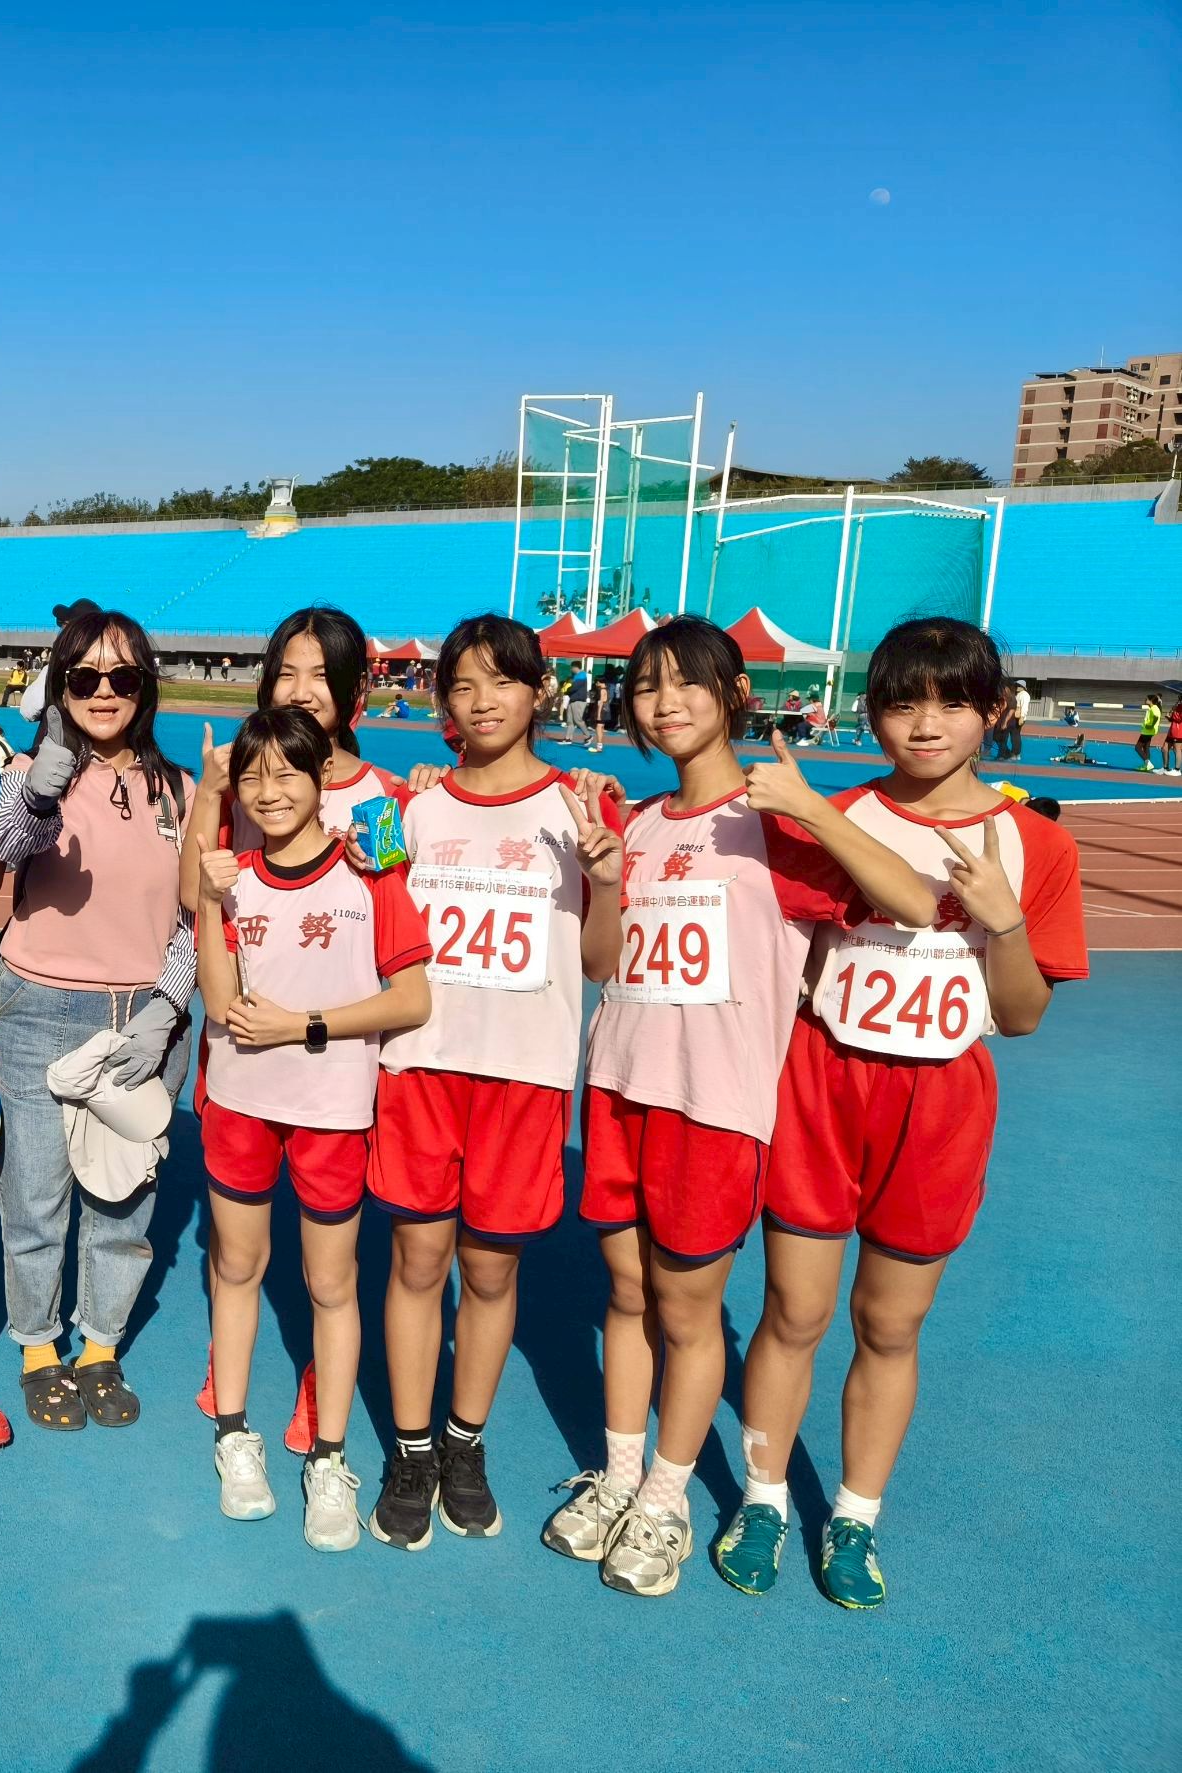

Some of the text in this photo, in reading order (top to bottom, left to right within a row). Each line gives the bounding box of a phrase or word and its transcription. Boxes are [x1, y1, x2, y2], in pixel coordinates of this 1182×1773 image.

[332, 908, 367, 922] 110023
[615, 922, 710, 986] 249
[836, 961, 971, 1040] 1246
